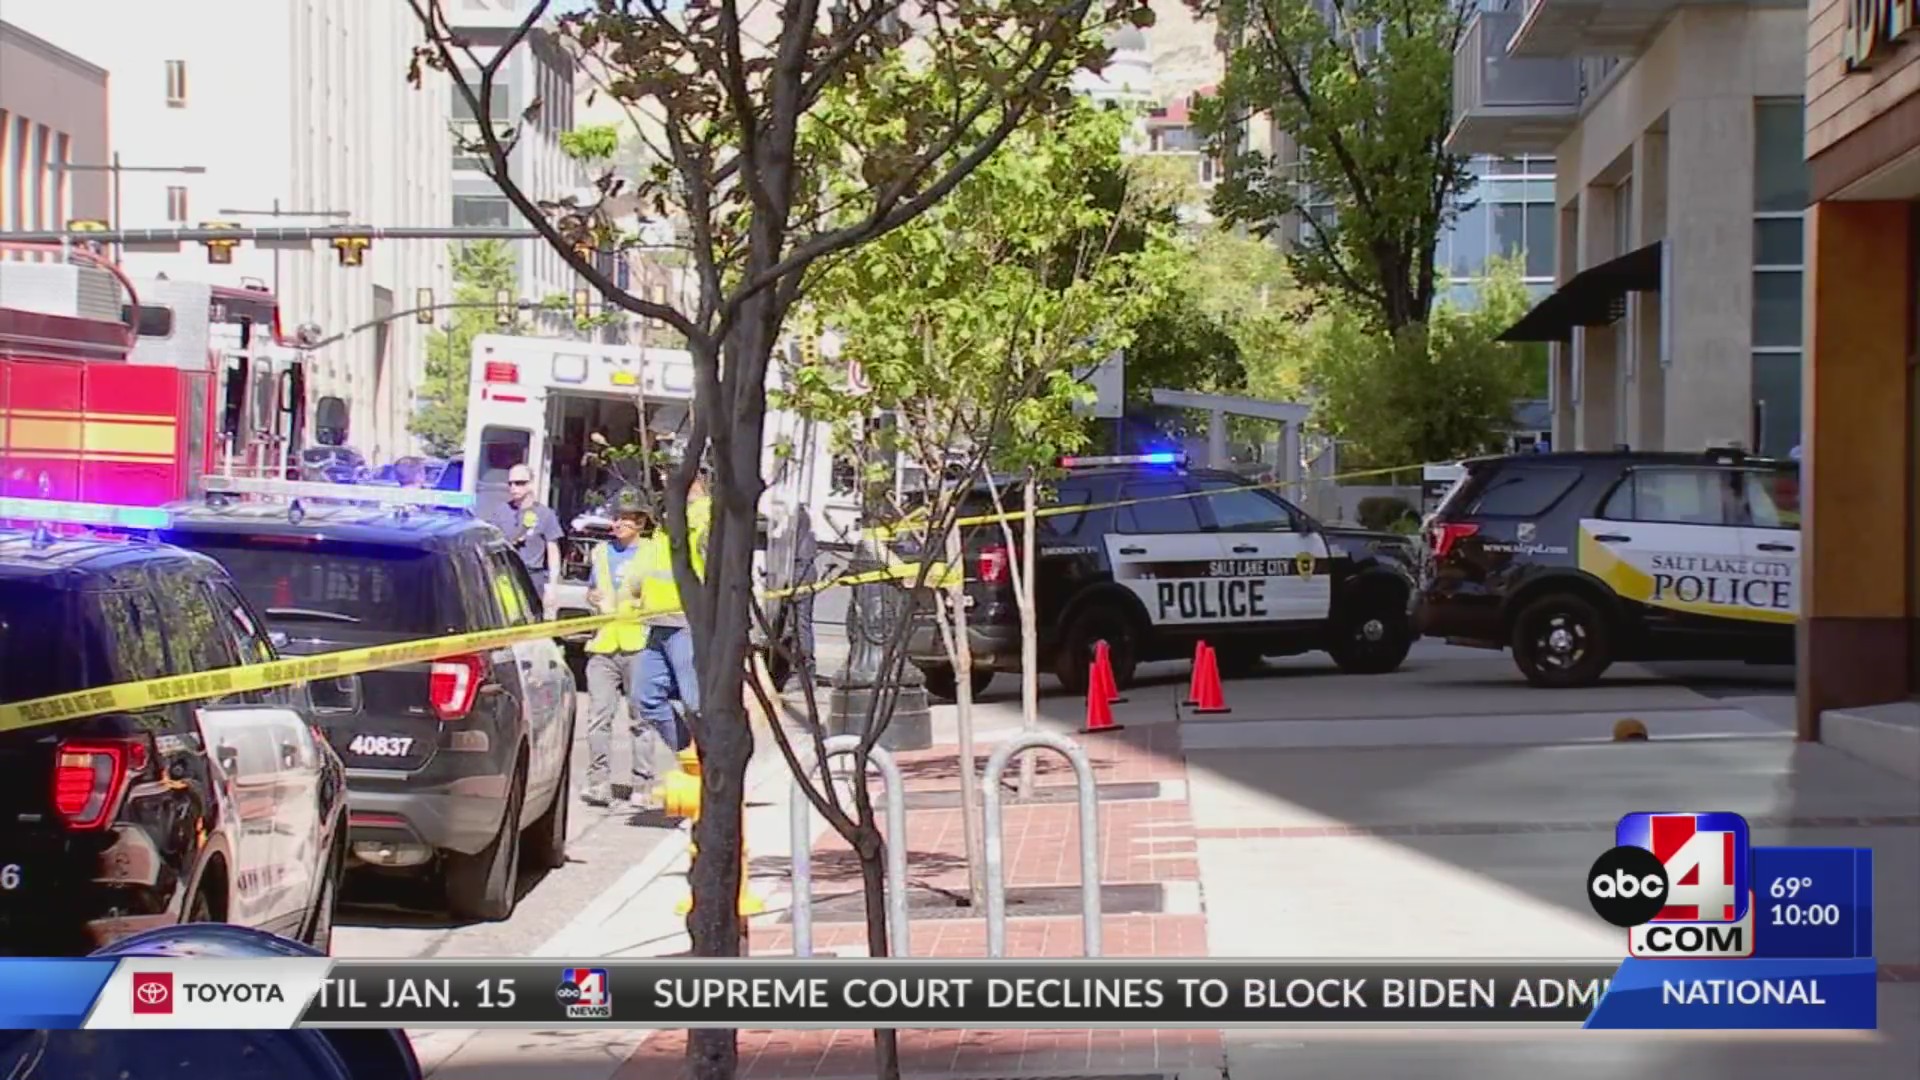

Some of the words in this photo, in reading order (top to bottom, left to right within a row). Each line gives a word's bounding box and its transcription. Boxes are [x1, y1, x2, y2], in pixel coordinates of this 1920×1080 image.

[1209, 561, 1235, 576] SALT
[1237, 561, 1265, 576] LAKE
[1267, 559, 1290, 575] CITY
[1651, 555, 1698, 571] SALT
[1701, 558, 1748, 574] LAKE
[1751, 561, 1791, 577] CITY
[1157, 580, 1268, 619] POLICE
[1652, 573, 1792, 608] POLICE
[349, 735, 413, 757] 40837
[0, 863, 20, 890] 6
